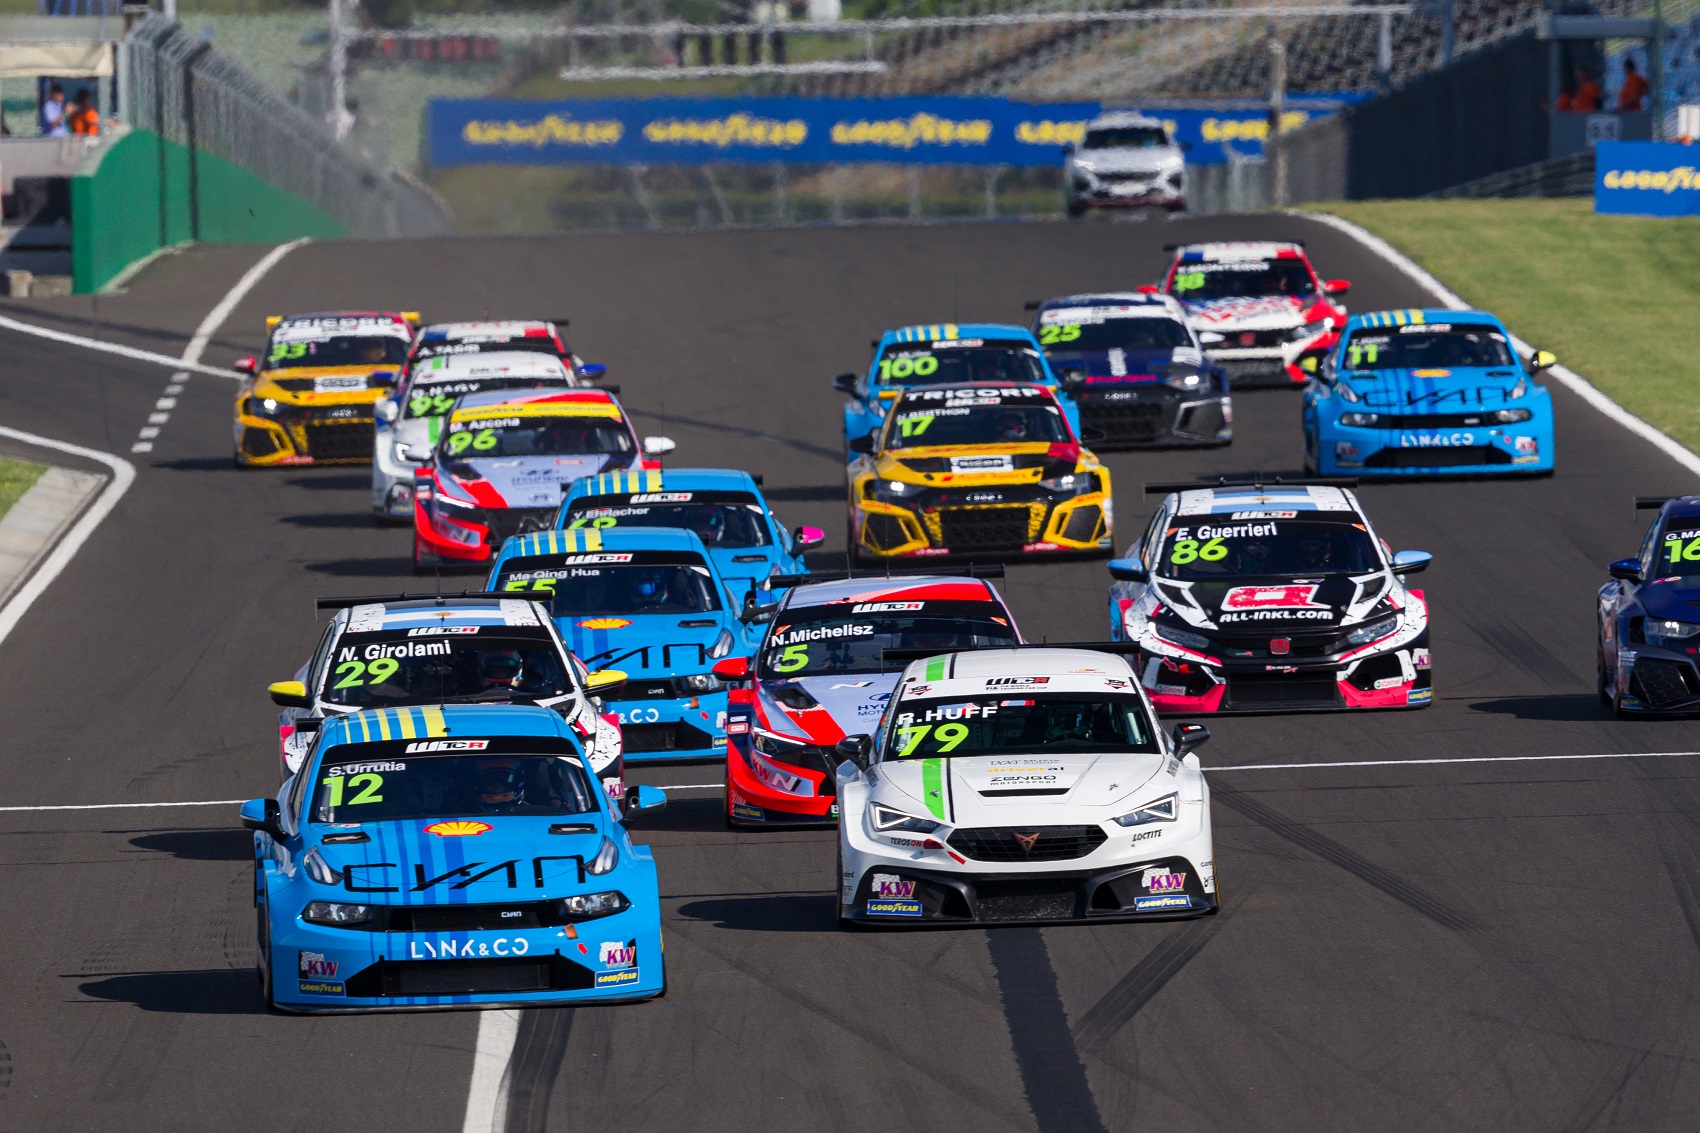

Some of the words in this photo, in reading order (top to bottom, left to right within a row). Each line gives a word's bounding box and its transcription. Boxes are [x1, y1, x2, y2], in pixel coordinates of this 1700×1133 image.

[1039, 324, 1082, 344] 25
[1347, 344, 1379, 366] 11
[879, 356, 938, 379] 100
[906, 388, 1042, 402] TRICORP
[469, 418, 520, 430] Azcona
[897, 416, 936, 438] 17
[448, 428, 498, 454] 96
[1175, 527, 1193, 541] E.
[1197, 522, 1278, 540] Guerrieri
[1170, 537, 1229, 564] 86
[1665, 537, 1700, 563] 16
[509, 573, 531, 582] Ma
[533, 569, 567, 580] Qing
[571, 568, 600, 577] Hua
[771, 624, 874, 647] N.Michelisz
[338, 646, 358, 663] N.
[364, 639, 451, 659] Girolami
[780, 643, 809, 673] 5
[333, 657, 399, 690] 29
[898, 705, 998, 725] R.HUFF
[405, 740, 490, 753] WTCR
[897, 722, 969, 757] 79
[328, 761, 407, 777] S.Urrutia
[322, 773, 384, 807] 12
[890, 837, 922, 848] TEROSON
[1132, 828, 1163, 842] LOCTITE
[880, 881, 916, 897] KW
[1149, 872, 1186, 892] KW
[871, 903, 919, 913] GOODYEAR
[1138, 897, 1187, 908] GOODYEAR
[606, 946, 636, 966] KW
[307, 960, 339, 977] KW
[598, 971, 637, 983] GOODYEAR
[301, 983, 343, 993] GOODYEAR
